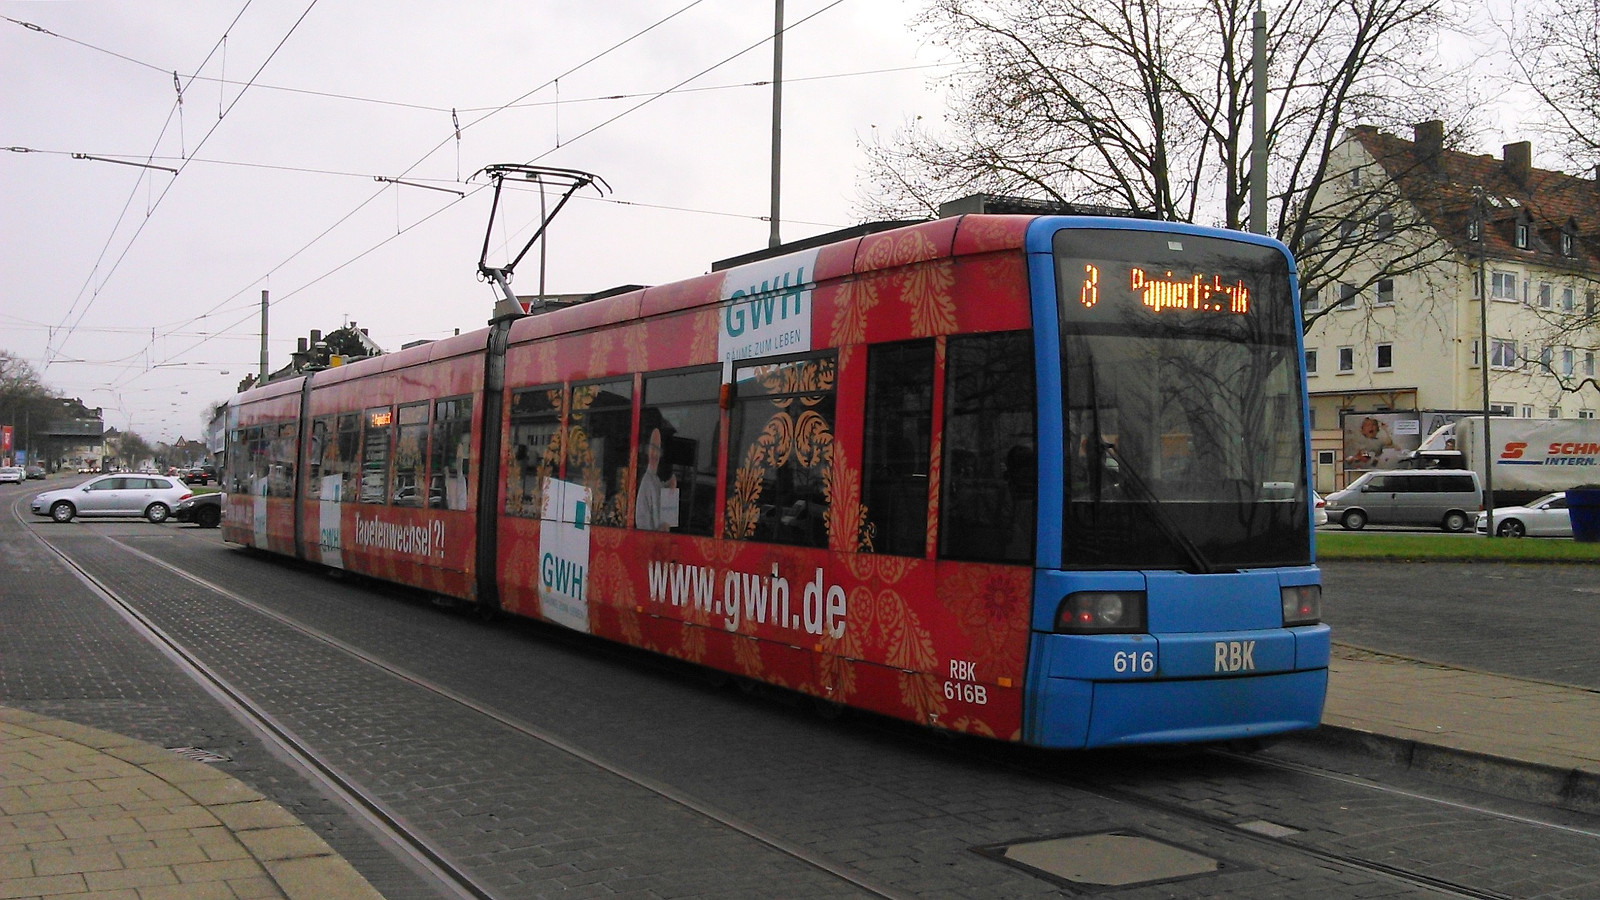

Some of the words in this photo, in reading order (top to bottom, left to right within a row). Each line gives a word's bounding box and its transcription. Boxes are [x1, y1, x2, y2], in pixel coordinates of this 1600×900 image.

[725, 266, 804, 338] GWH
[755, 338, 772, 356] ZUM
[775, 329, 801, 349] LEBEN
[354, 512, 432, 557] Tapetenwechsel
[542, 552, 583, 601] GWH
[648, 560, 847, 639] www.gwh.de
[950, 659, 976, 682] RBK
[1113, 651, 1154, 673] 616
[1214, 641, 1255, 672] RBK
[944, 681, 987, 705] 616B
